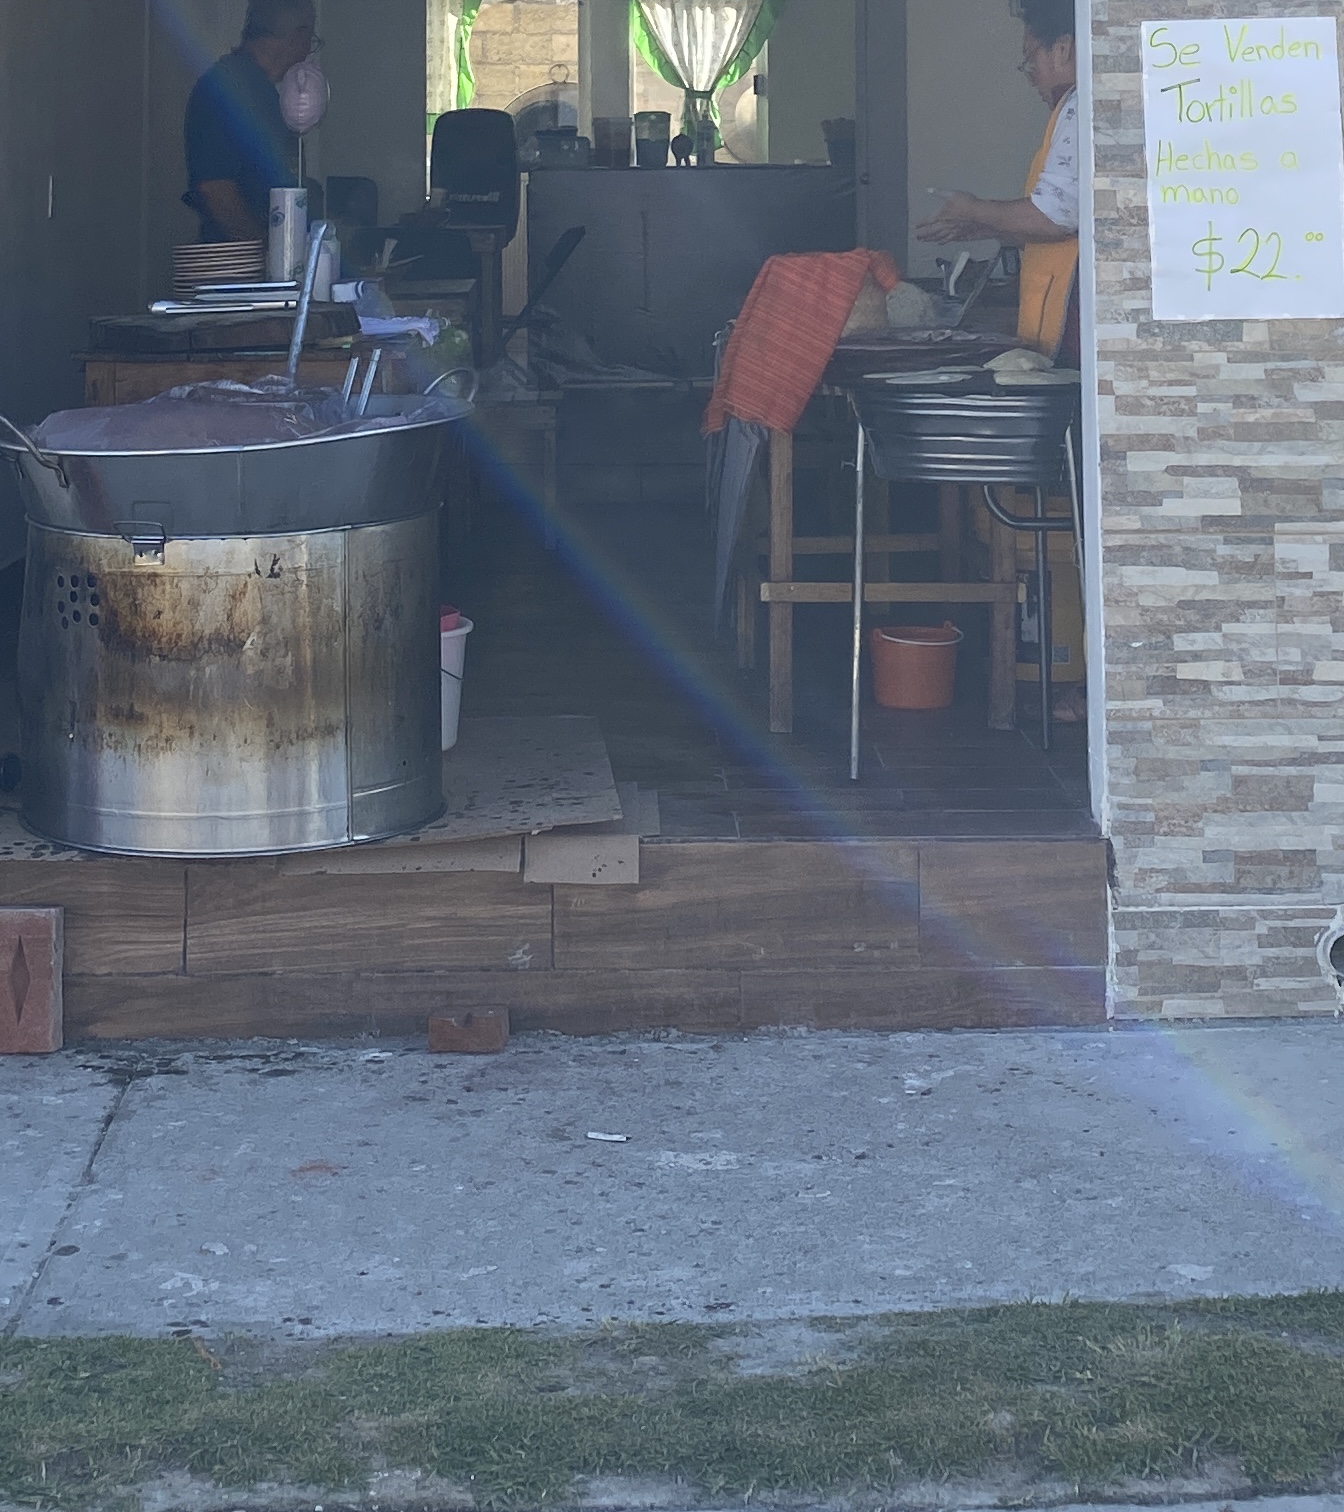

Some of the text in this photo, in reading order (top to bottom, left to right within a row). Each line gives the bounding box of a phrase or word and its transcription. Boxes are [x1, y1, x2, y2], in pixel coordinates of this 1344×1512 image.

[1149, 24, 1322, 69] Se Venden
[1160, 77, 1298, 124] Tortillas
[1156, 139, 1300, 177] Hechas a
[1160, 183, 1241, 206] mano
